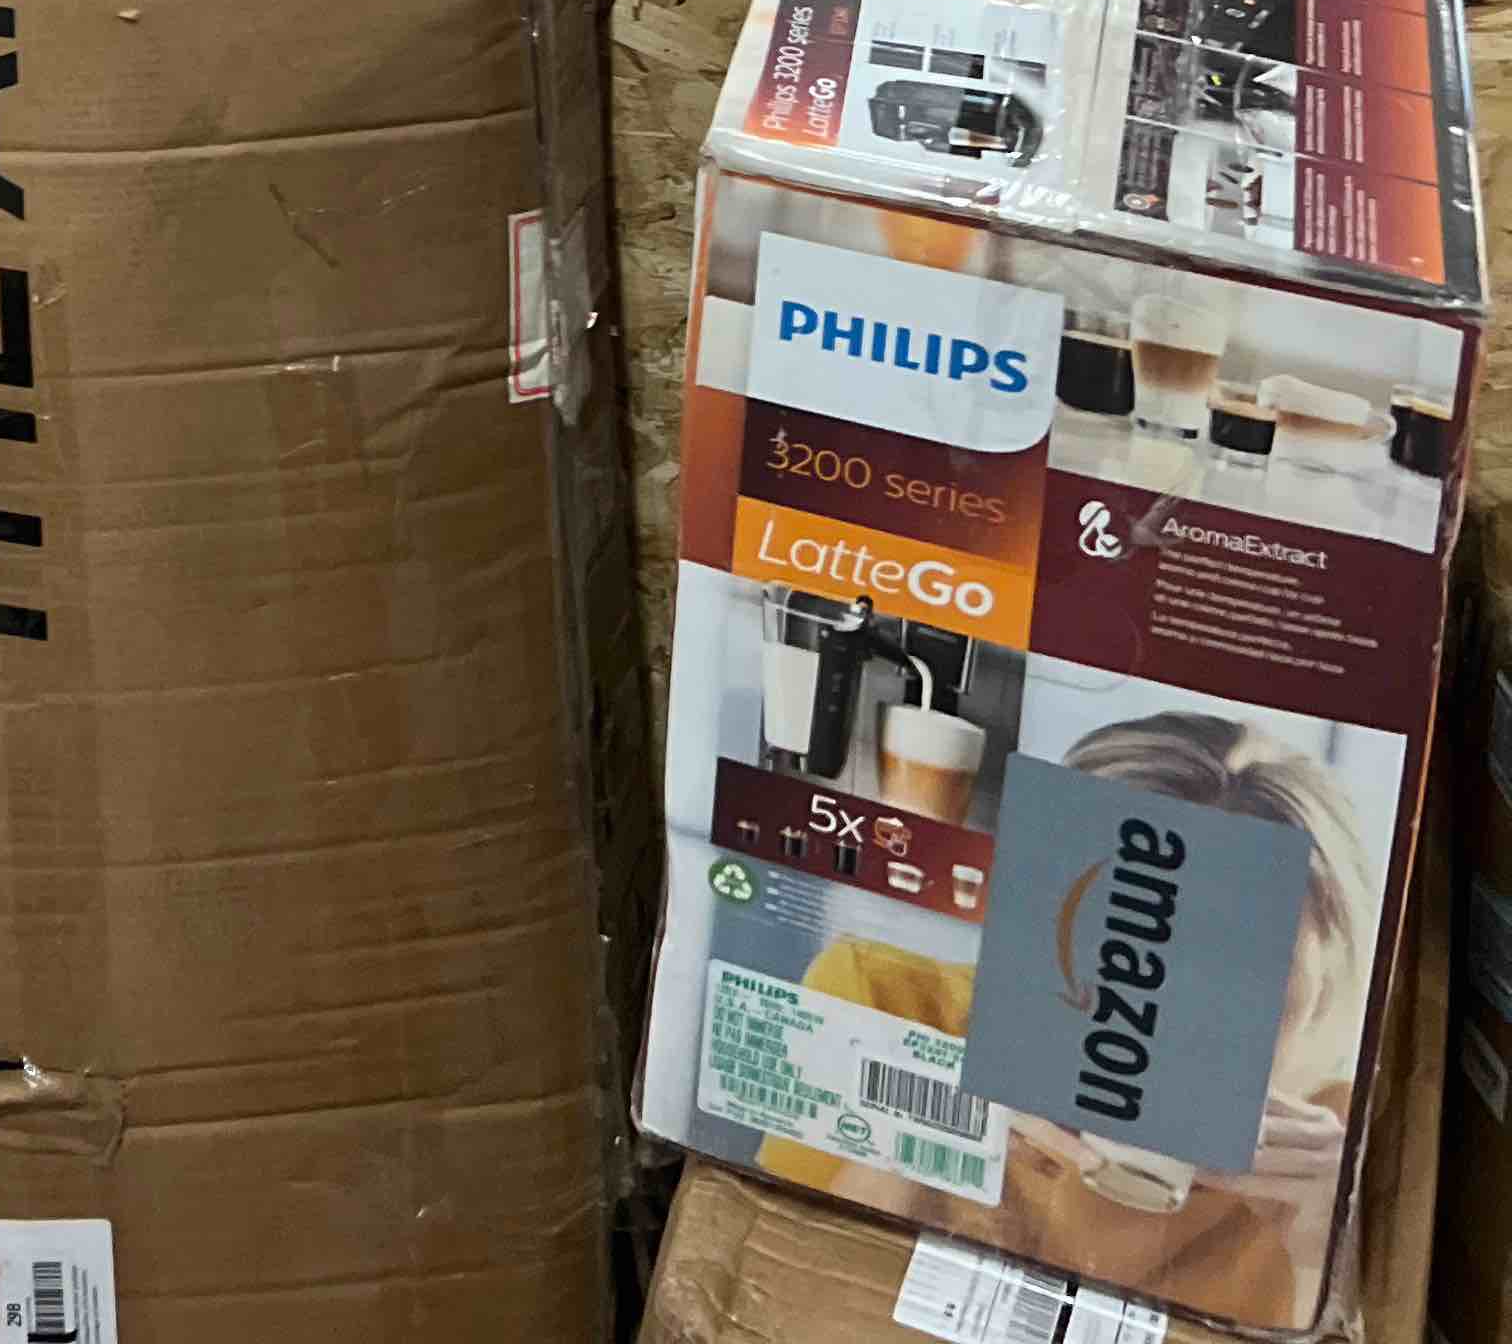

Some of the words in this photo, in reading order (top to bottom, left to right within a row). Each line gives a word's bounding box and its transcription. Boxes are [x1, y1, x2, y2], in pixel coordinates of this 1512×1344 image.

[787, 5, 814, 45] series
[772, 45, 806, 83] 3200
[801, 77, 839, 138] LatteGo
[779, 300, 1028, 393] PHILIPS
[767, 442, 872, 489] 3200
[884, 473, 1009, 525] series
[757, 519, 995, 617] LatteGo
[1161, 516, 1331, 570] AromaExtract
[808, 793, 866, 844] 5x
[722, 971, 799, 1005] PHILIPS
[1074, 817, 1189, 1124] amazon
[7, 1282, 22, 1327] 298
